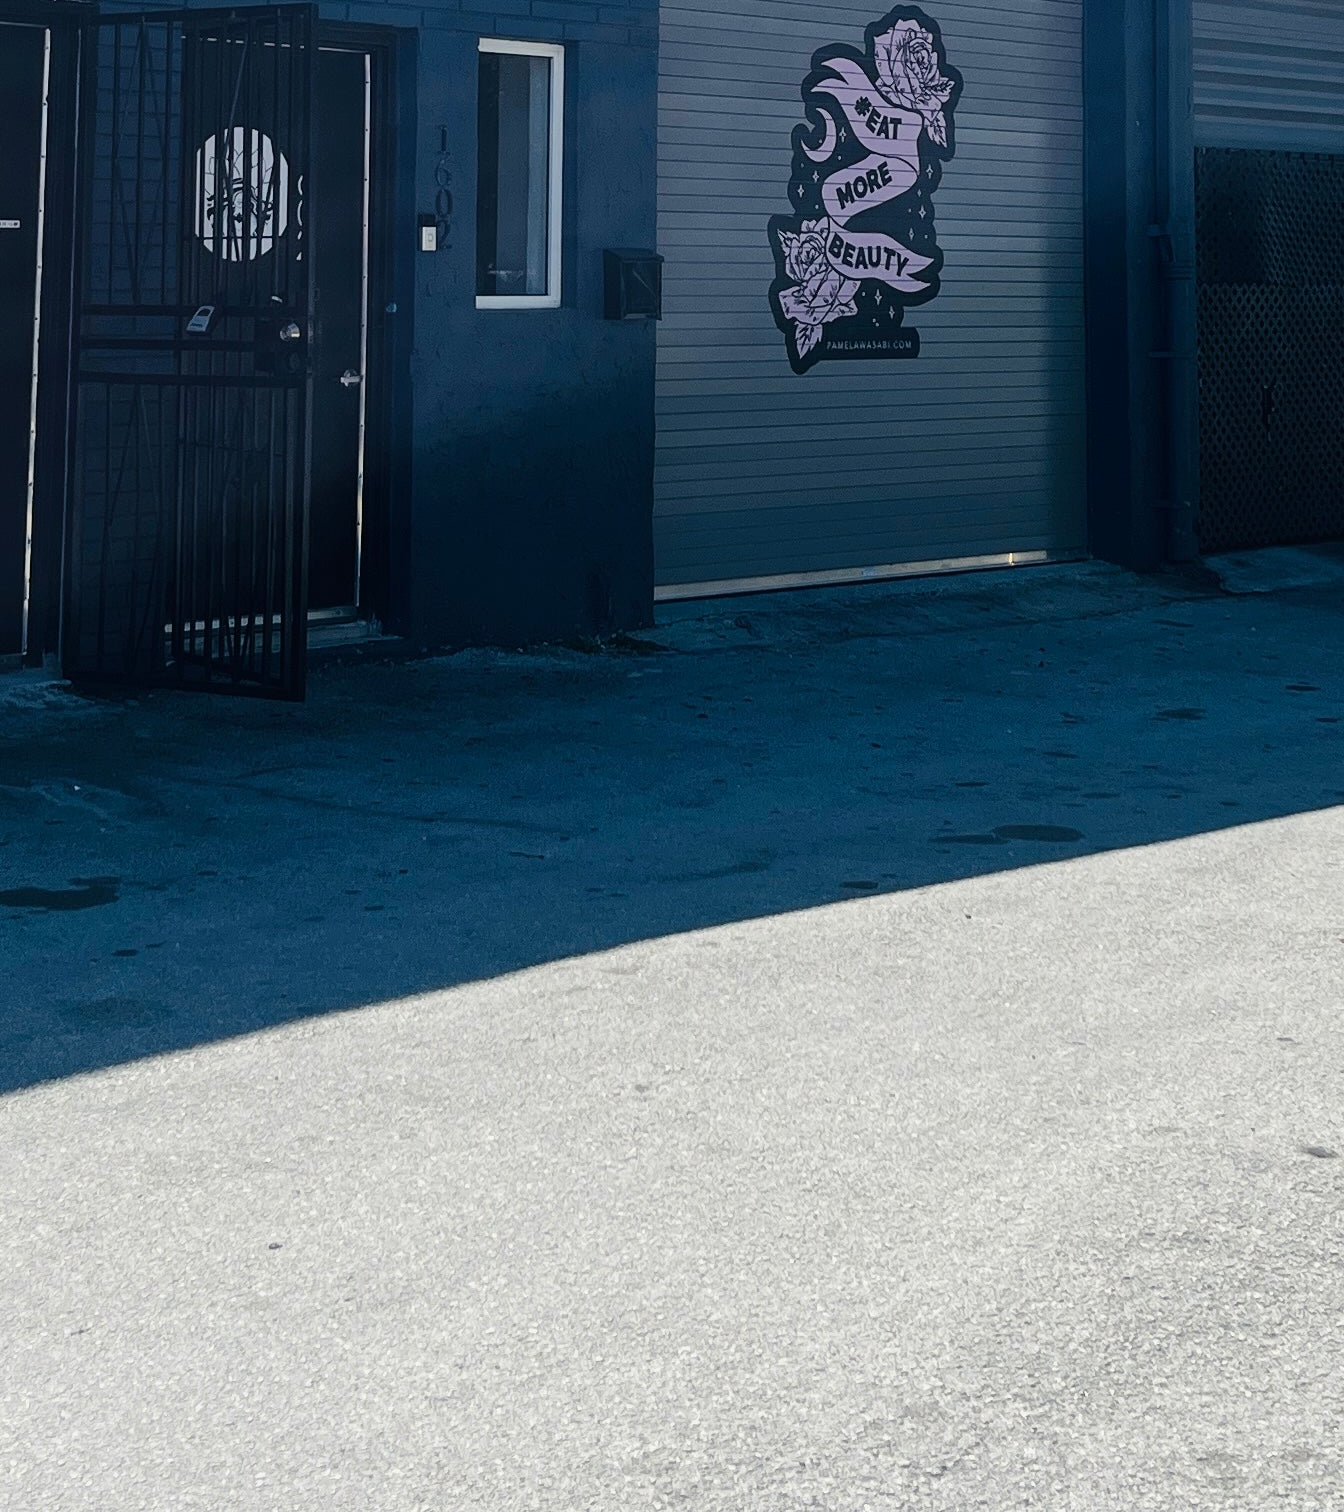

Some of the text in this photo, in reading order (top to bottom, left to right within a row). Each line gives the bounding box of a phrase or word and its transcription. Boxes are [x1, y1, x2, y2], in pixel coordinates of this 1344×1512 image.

[865, 107, 903, 141] EAT
[835, 161, 893, 210] MORE
[827, 231, 910, 277] BEAUTY
